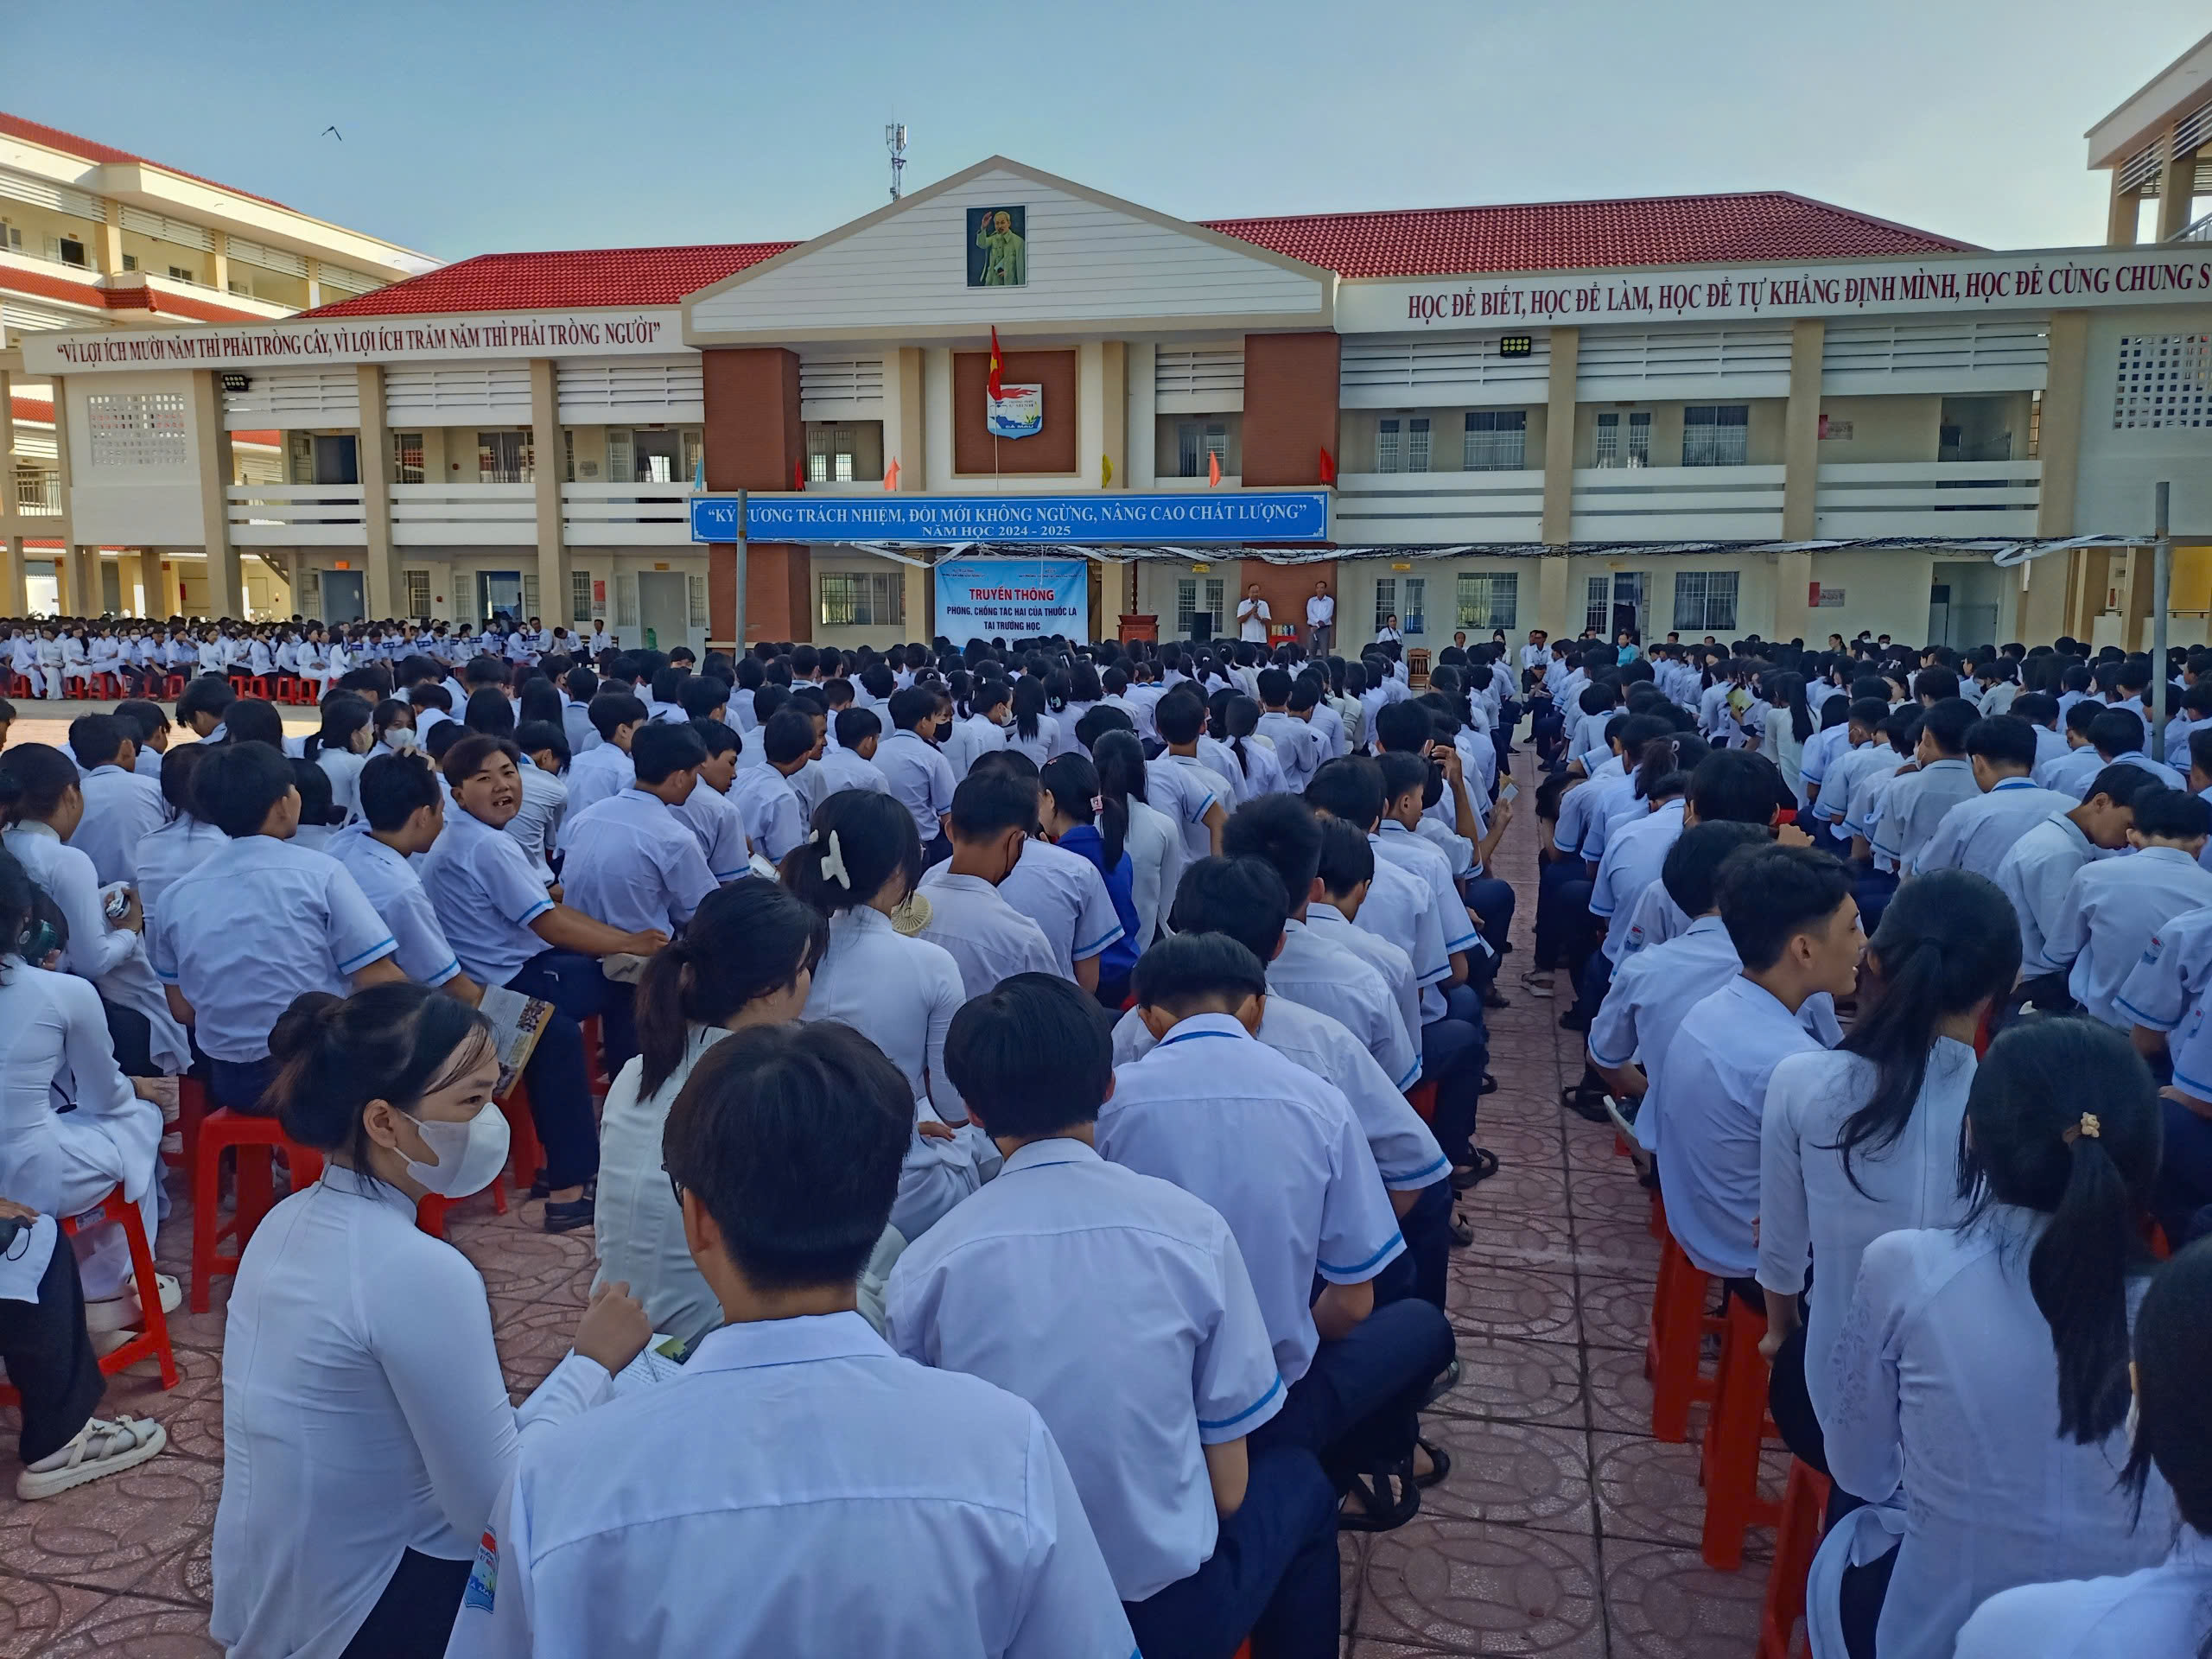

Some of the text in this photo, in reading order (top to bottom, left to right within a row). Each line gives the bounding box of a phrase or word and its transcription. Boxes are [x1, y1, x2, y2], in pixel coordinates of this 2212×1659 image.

[1408, 294, 1447, 325] HỌC
[1452, 286, 1476, 317] ĐỂ
[1480, 285, 1526, 319] BIẾT,
[1530, 289, 1572, 320] HỌC
[1576, 282, 1600, 312] ĐỂ
[1607, 280, 1653, 315] LÀM,
[1658, 284, 1701, 315] HỌC
[1706, 276, 1732, 308] ĐỂ
[1738, 276, 1767, 313] TỰ
[1844, 276, 1897, 308] ĐỊNH
[1899, 268, 1960, 303] MÌNH,
[1965, 271, 2011, 303] HỌC
[2014, 263, 2043, 296] ĐỂ
[2049, 262, 2109, 295] CÙNG
[2116, 264, 2194, 292] CHUNG
[80, 340, 102, 367] LỢI
[104, 337, 127, 362] ÍCH
[130, 335, 165, 360] MƯỜI
[167, 334, 196, 359] NĂM
[197, 333, 220, 358] THÌ
[224, 332, 253, 357] PHẢI
[304, 328, 332, 357] CÂY,
[334, 327, 348, 353] VÌ
[352, 329, 376, 356] LỢI
[379, 326, 403, 351] ÍCH
[406, 323, 447, 349] TRĂM
[449, 323, 480, 348] NĂM
[482, 321, 508, 346] THÌ
[510, 319, 545, 346] PHẢI
[796, 505, 848, 523] TRÁCH
[851, 507, 906, 526] NHIỆM,
[940, 505, 971, 523] MỚI
[976, 504, 1032, 523] KHÔNG
[1037, 503, 1097, 524] NGỪNG,
[1102, 502, 1147, 521] NÂNG
[1150, 505, 1185, 521] CAO
[1189, 501, 1236, 521] CHẤT
[922, 524, 957, 537] NĂM
[961, 526, 995, 539] HỌC
[998, 525, 1028, 536] 2024
[1040, 525, 1071, 536] 2025
[1014, 588, 1054, 601] THÔNG
[1026, 621, 1040, 632] HỌC
